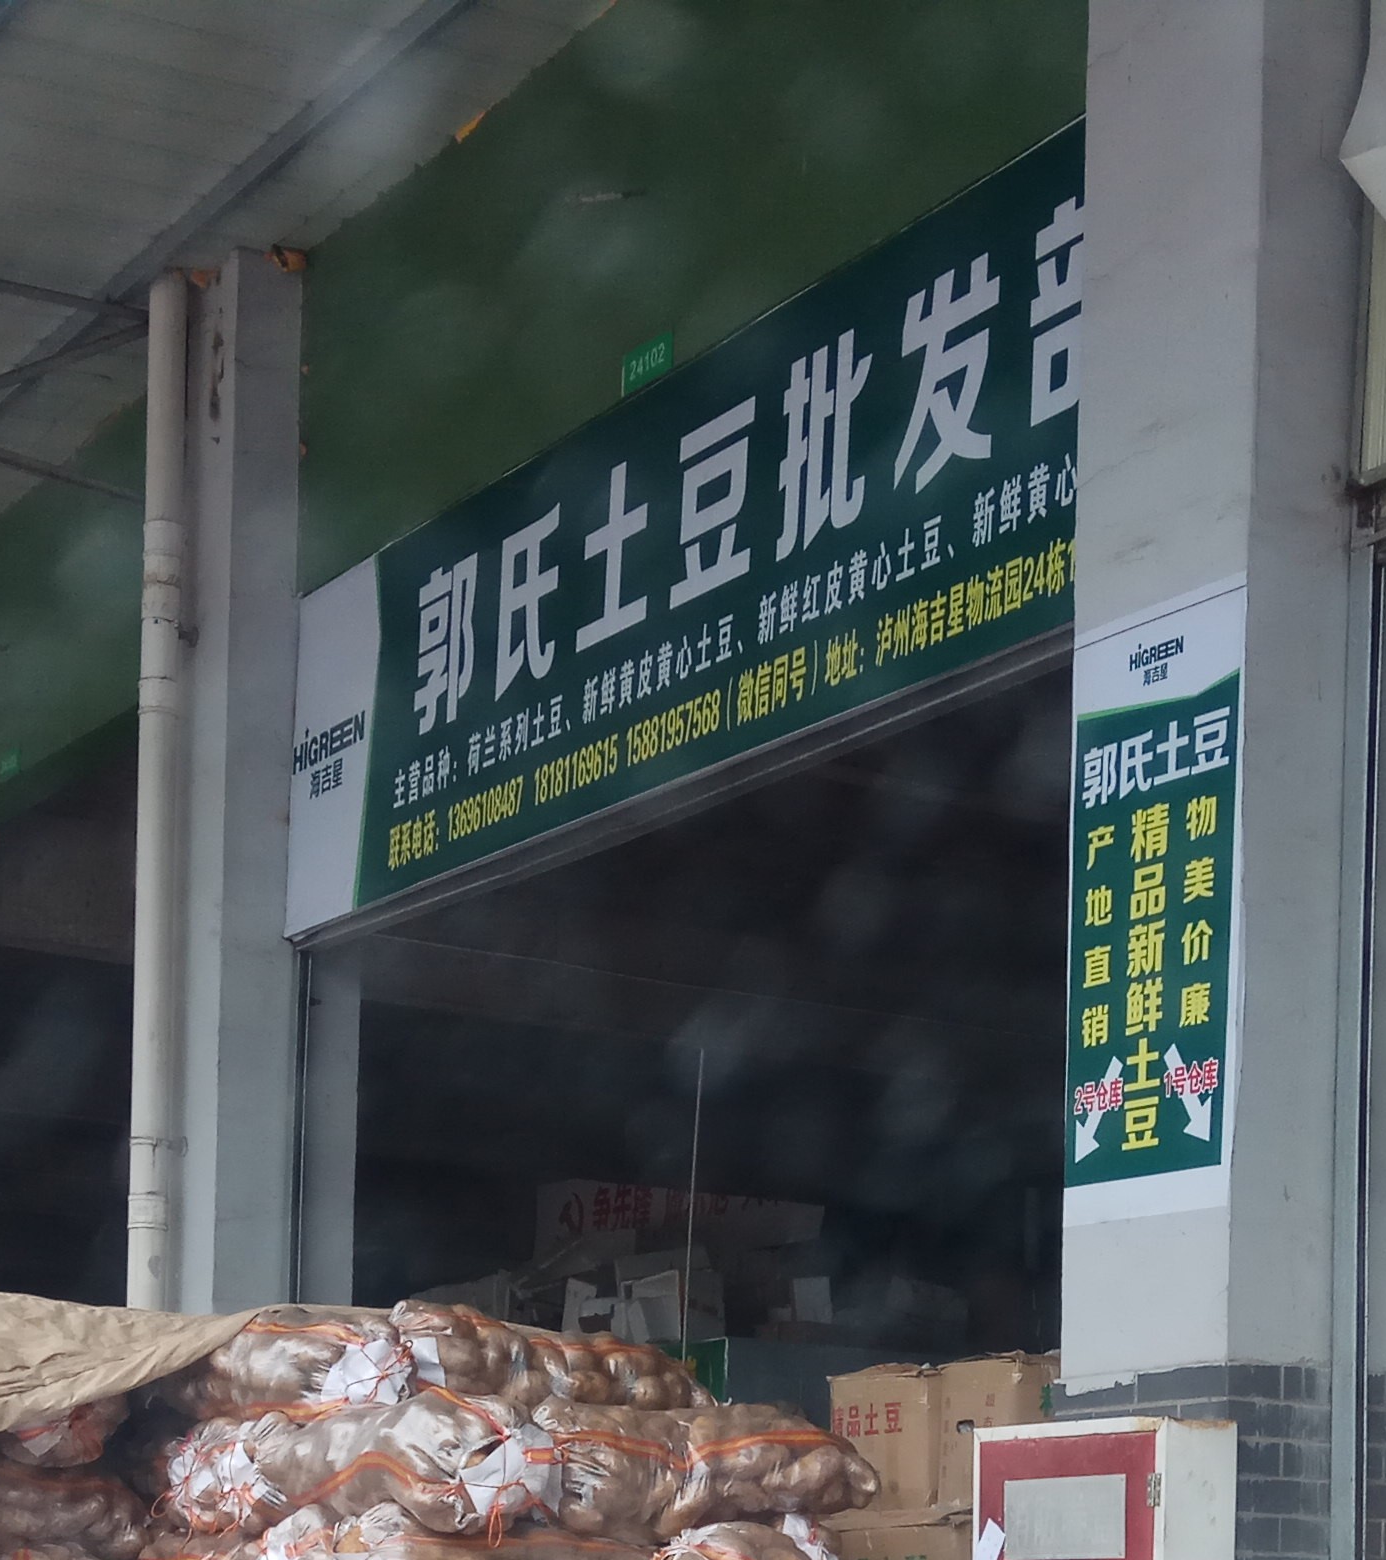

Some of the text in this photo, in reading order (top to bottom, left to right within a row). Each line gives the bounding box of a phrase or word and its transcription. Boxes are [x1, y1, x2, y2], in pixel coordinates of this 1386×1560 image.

[629, 341, 665, 381] 24102
[309, 757, 343, 800] 海吉星
[1083, 706, 1231, 809] 郭氏土豆
[1081, 825, 1115, 1049] 产地直销
[1179, 794, 1217, 1029] 物美价廉
[1121, 802, 1170, 1152] 精品新鲜土豆
[1074, 1077, 1123, 1116] 2号仓库
[1163, 1057, 1219, 1099] 1号仓库
